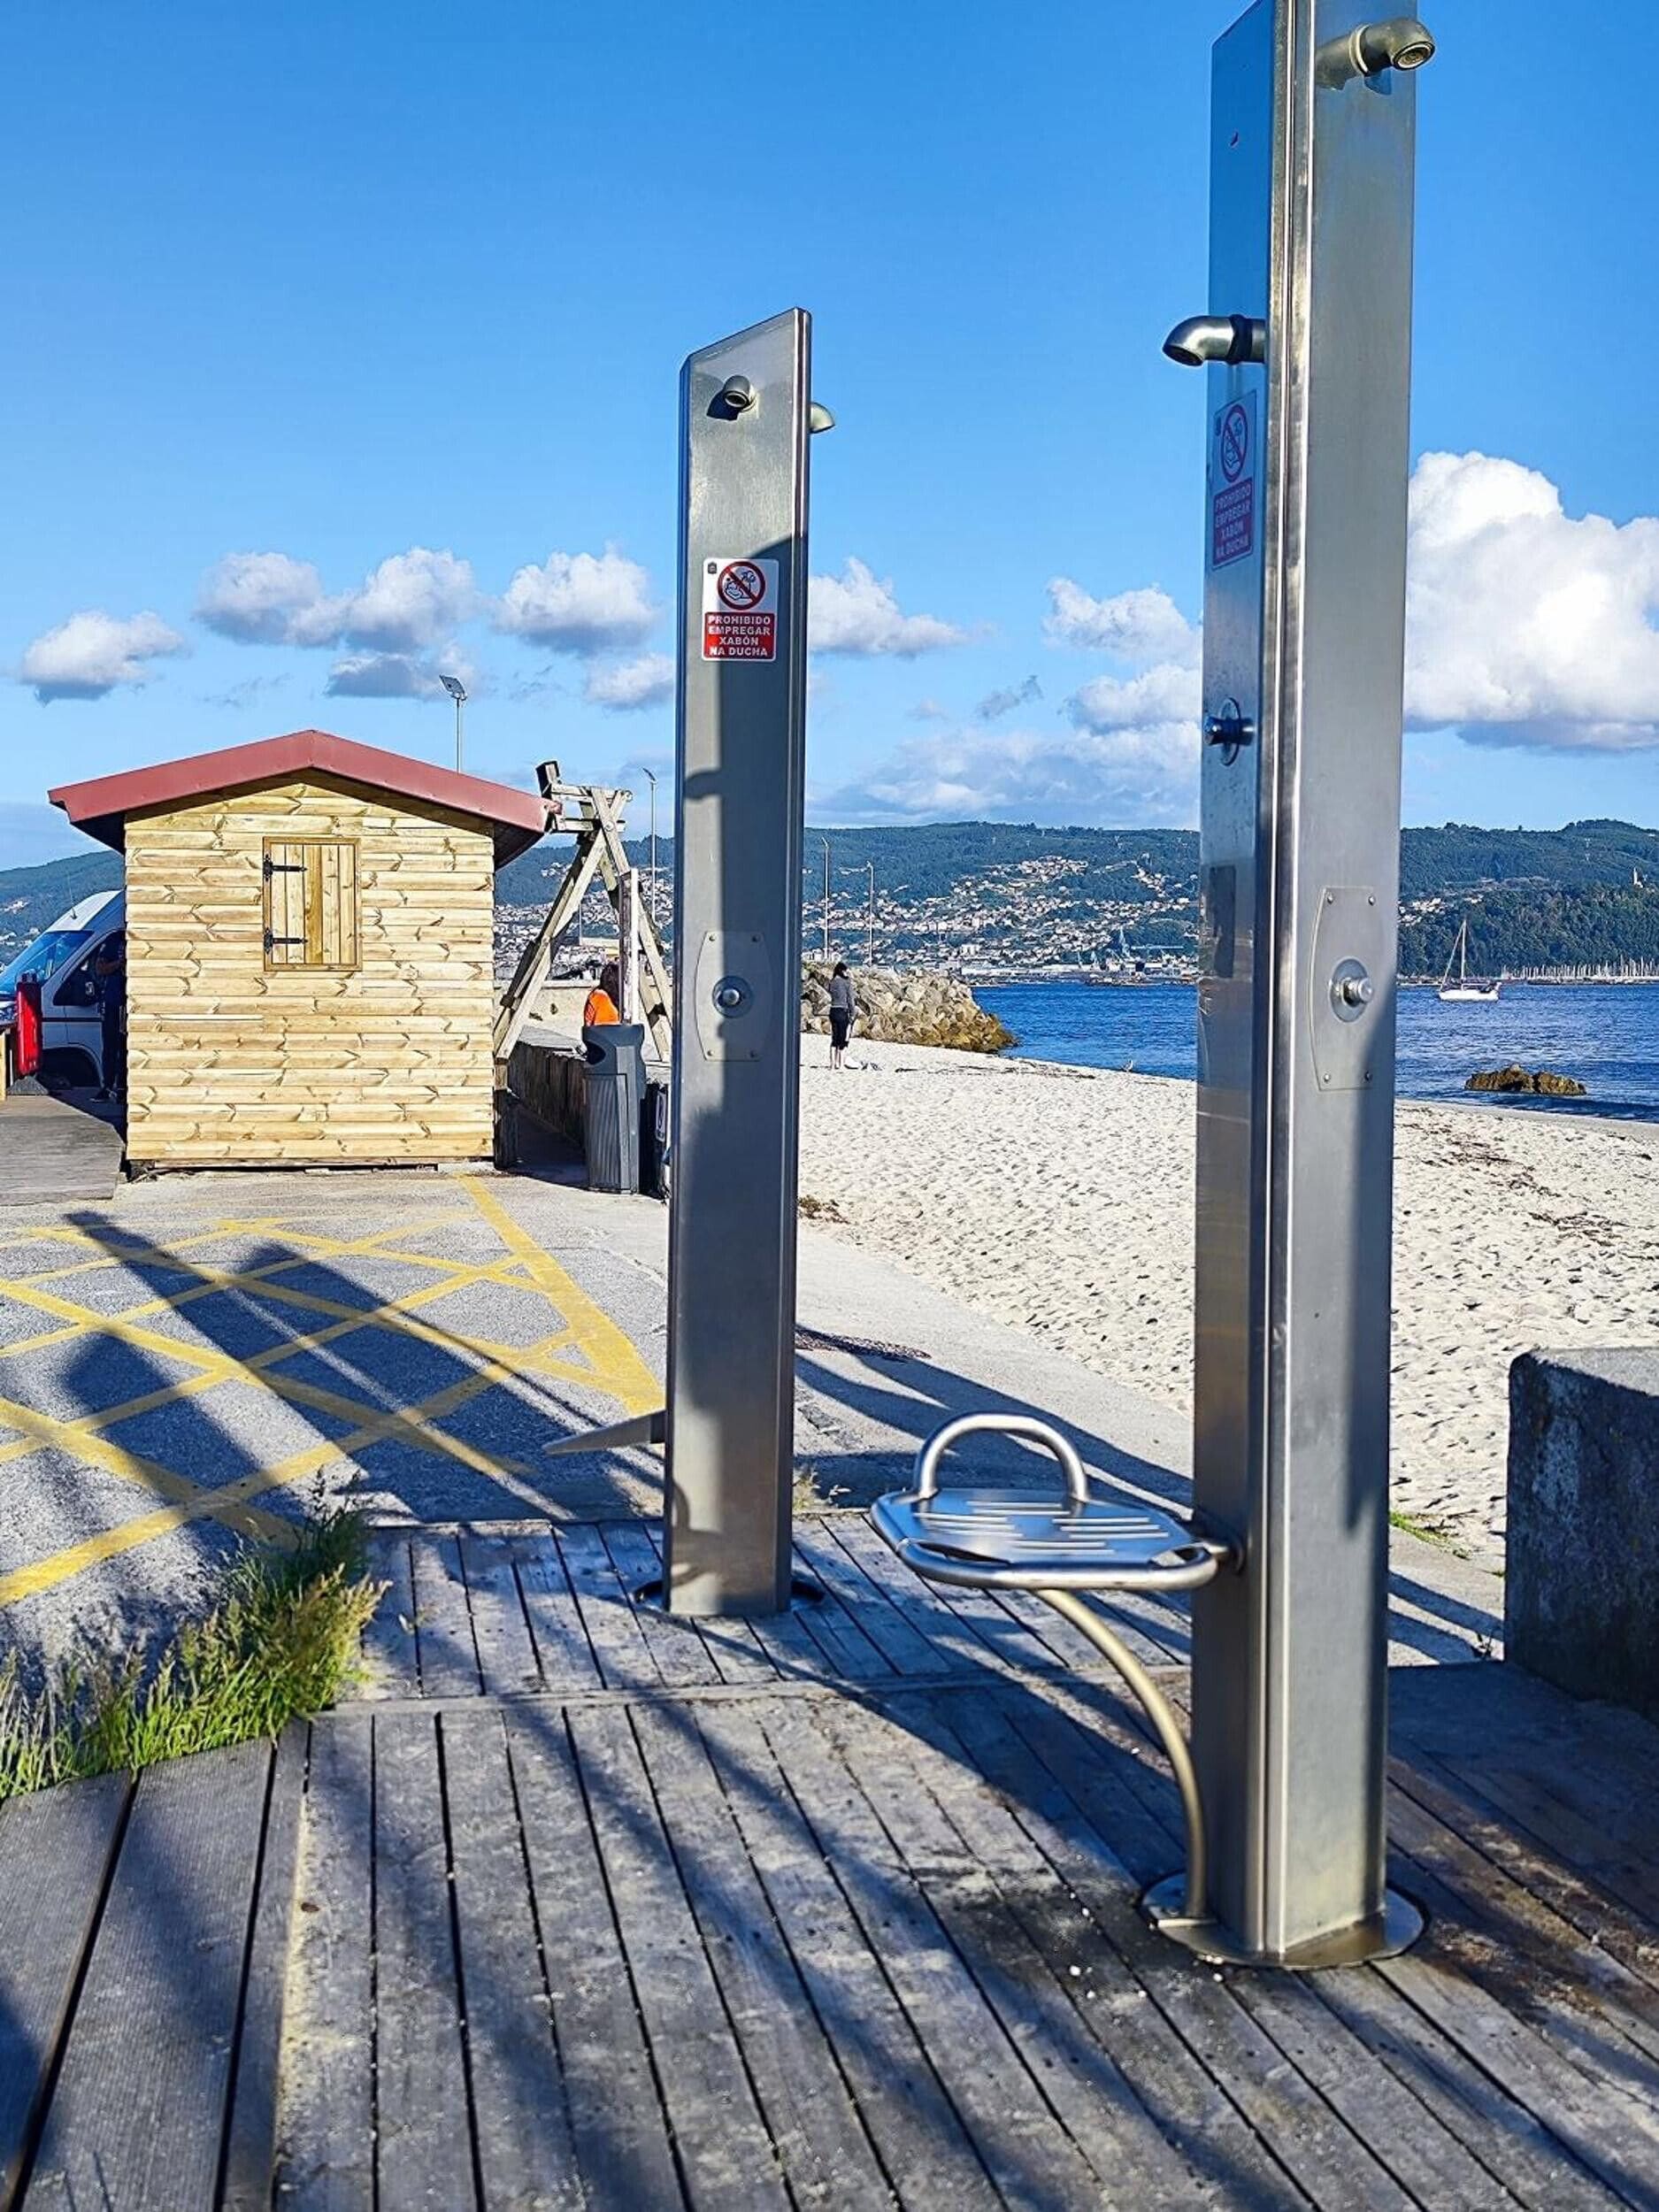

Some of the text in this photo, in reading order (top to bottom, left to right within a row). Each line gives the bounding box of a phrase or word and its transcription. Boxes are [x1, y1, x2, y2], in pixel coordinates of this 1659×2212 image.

[708, 615, 771, 625] PROHIBIDO
[708, 626, 771, 635] EMPREGAR
[718, 635, 759, 645] XABÓN
[710, 647, 768, 656] NA DUCHA
